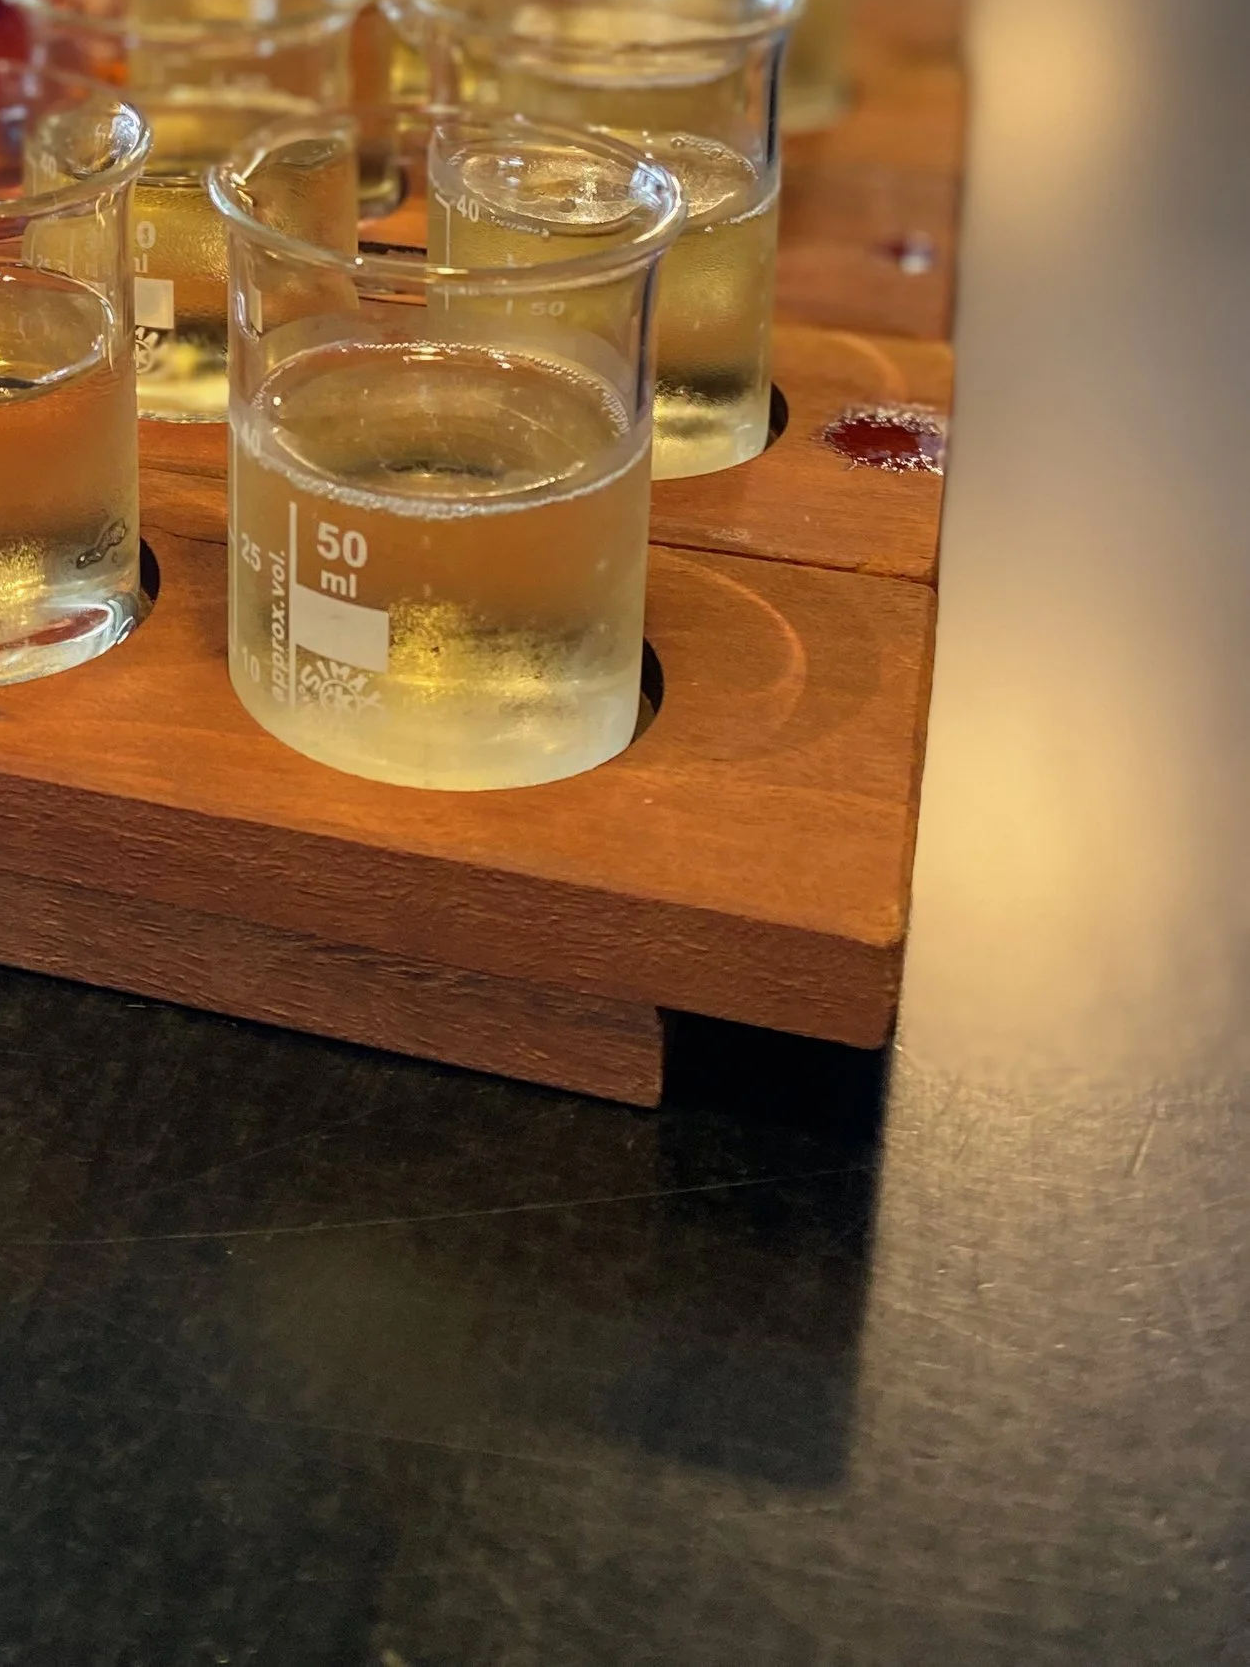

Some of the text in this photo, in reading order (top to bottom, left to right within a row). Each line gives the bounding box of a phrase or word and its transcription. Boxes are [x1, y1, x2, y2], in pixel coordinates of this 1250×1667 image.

[456, 195, 480, 222] 40
[136, 221, 156, 249] 0
[240, 533, 262, 573] 25
[316, 520, 369, 569] 50
[320, 569, 358, 600] ml
[269, 549, 287, 703] approx.vol.
